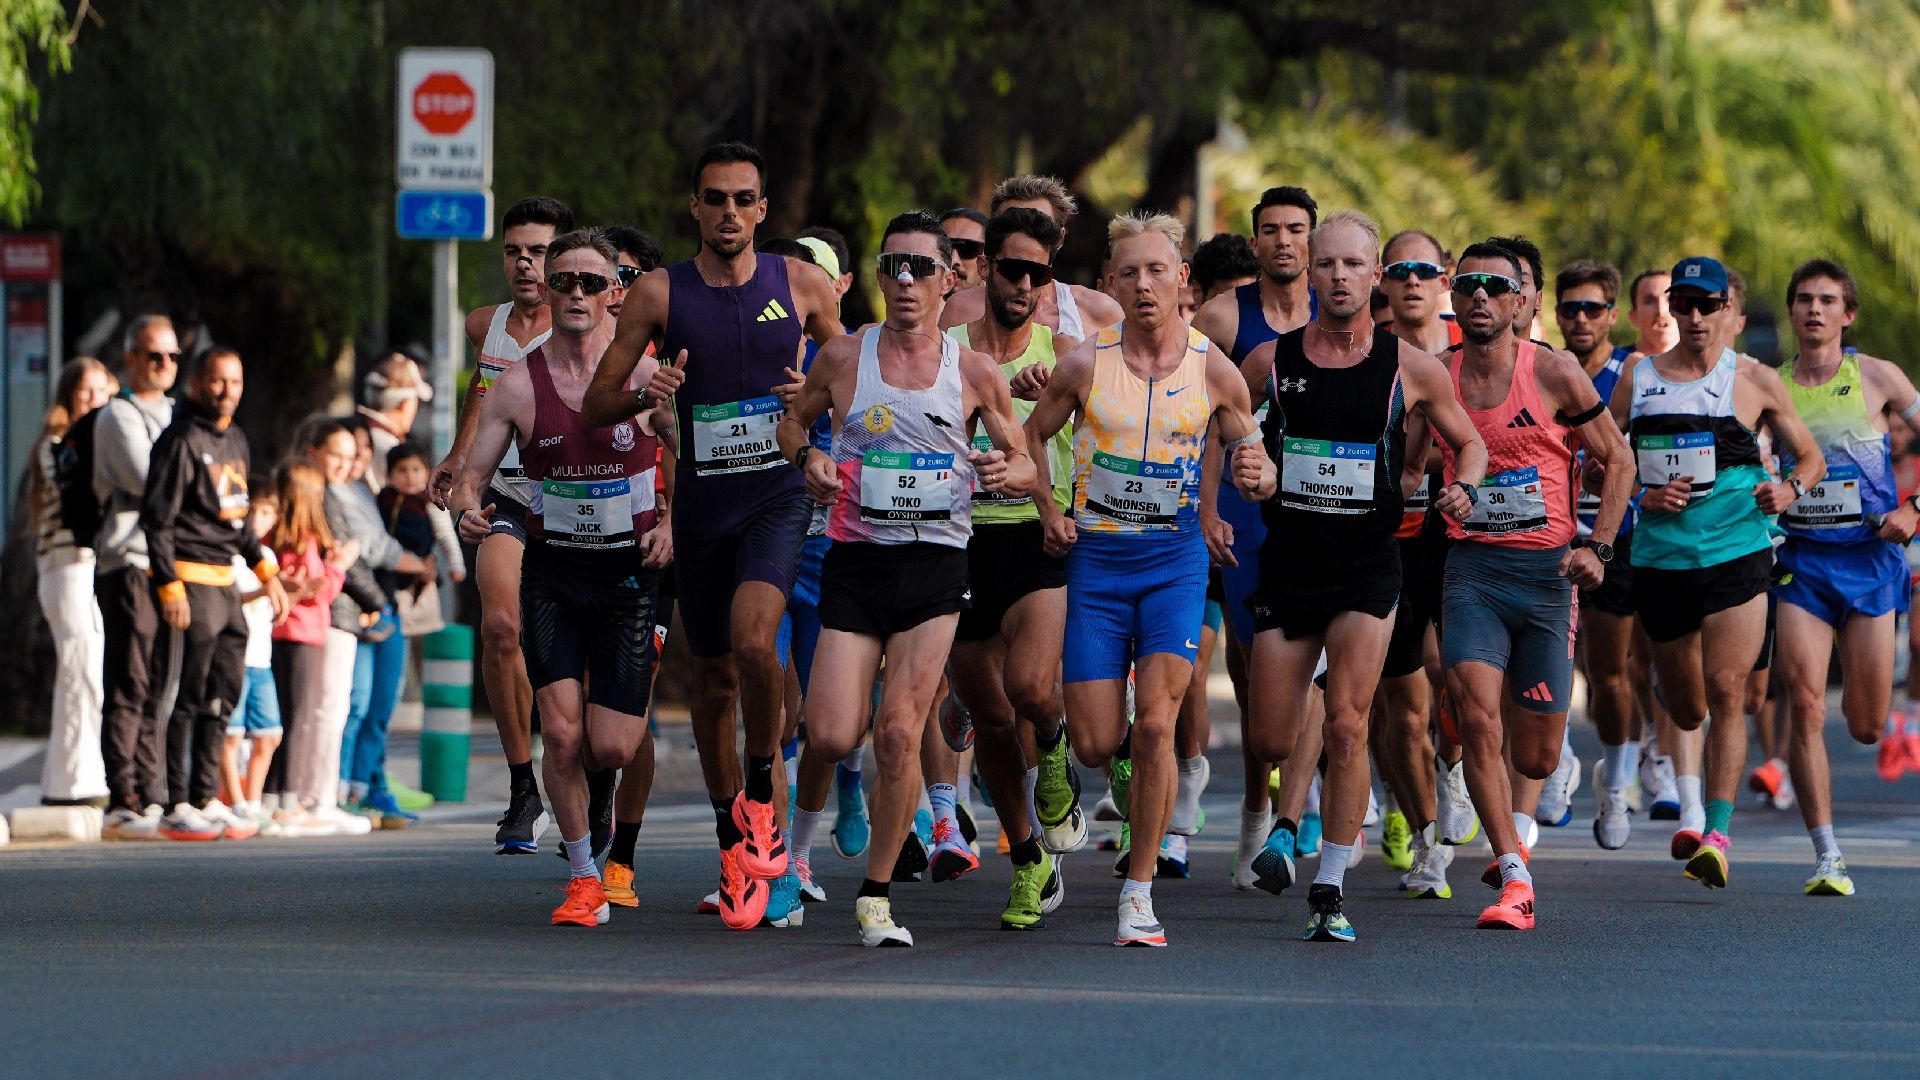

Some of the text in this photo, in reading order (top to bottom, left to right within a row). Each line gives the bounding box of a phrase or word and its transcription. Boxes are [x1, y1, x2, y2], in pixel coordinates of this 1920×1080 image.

[417, 95, 472, 113] STOP
[450, 143, 476, 159] BUS
[756, 401, 777, 410] ZURICH
[731, 423, 747, 436] 21
[539, 435, 563, 448] soar
[711, 439, 772, 458] SELVAROLO
[727, 456, 761, 467] OYSHO
[927, 458, 949, 466] ZURICH
[1665, 454, 1680, 466] 71
[552, 464, 624, 477] MULLINGAR
[1318, 463, 1336, 476] 54
[898, 476, 916, 488] 52
[1510, 473, 1533, 481] ZURICH
[603, 485, 625, 494] ZURICH
[1124, 481, 1143, 493] 23
[1300, 481, 1353, 496] THOMSON
[1810, 487, 1825, 498] 69
[891, 496, 921, 508] YOKO
[1104, 494, 1161, 513] SIMONSEN
[1308, 497, 1341, 507] OYSHO
[1488, 492, 1505, 504] 30
[577, 504, 595, 516] 35
[887, 510, 921, 519] OYSHO
[1797, 503, 1844, 515] BODIRSKY
[1112, 511, 1146, 522] OYSHO
[1487, 511, 1515, 521] Pinto
[573, 522, 602, 534] JACK
[1487, 522, 1519, 531] OYSHO
[571, 535, 604, 544] OYSHO
